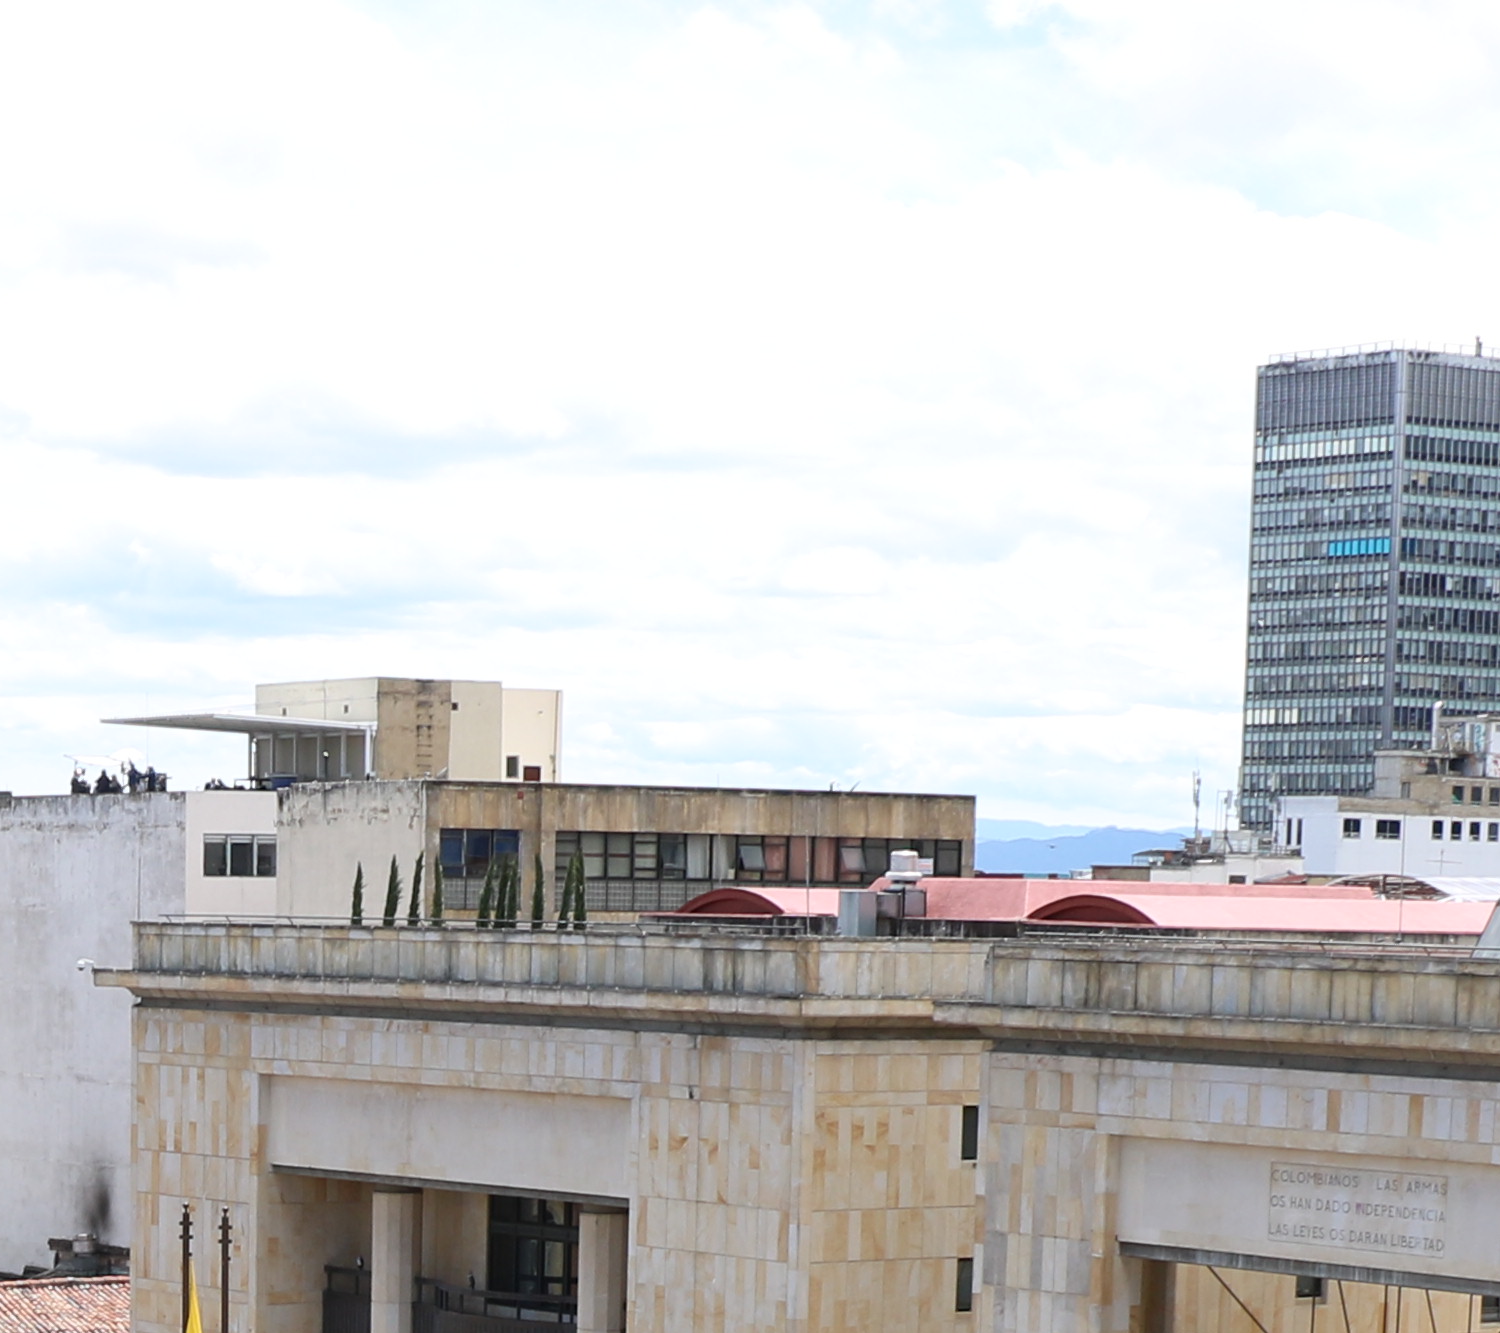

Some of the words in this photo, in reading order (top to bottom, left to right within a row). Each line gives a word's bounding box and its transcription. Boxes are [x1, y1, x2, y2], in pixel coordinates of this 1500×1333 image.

[1271, 1170, 1359, 1188] COLOMBIANOS
[1376, 1178, 1398, 1192] LAS
[1406, 1180, 1447, 1196] ARMAS
[1270, 1195, 1286, 1207] OS
[1290, 1196, 1311, 1209] HAN
[1315, 1198, 1350, 1214] DADO
[1355, 1202, 1445, 1223] INDEPENDENCIA
[1268, 1223, 1289, 1236] LAS
[1293, 1225, 1325, 1240] LEYES
[1329, 1228, 1345, 1242] OS
[1390, 1234, 1445, 1252] LIBERTAD
